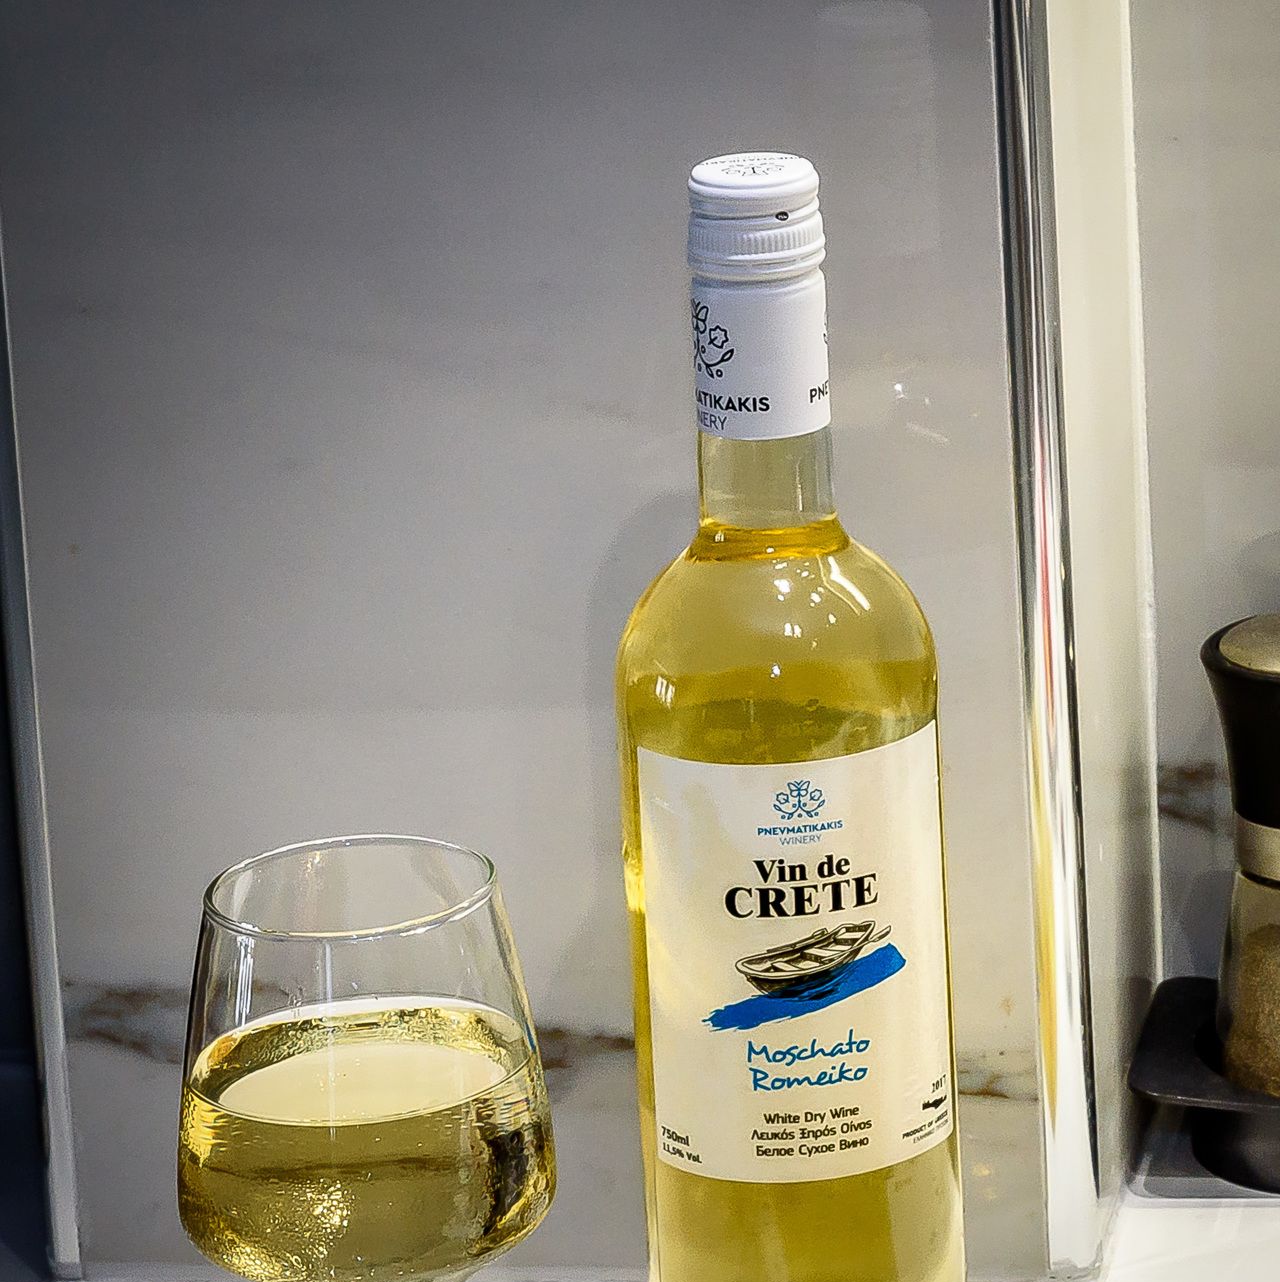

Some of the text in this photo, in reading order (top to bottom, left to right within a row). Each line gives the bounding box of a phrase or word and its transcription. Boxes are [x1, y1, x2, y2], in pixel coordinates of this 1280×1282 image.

[757, 820, 843, 836] PNEVMATIKAKIS
[779, 834, 822, 846] WINERY
[753, 854, 851, 884] Vin de
[725, 873, 879, 918] CRETE
[747, 1028, 870, 1066] Moschato
[749, 1062, 868, 1091] Romeiko
[764, 1107, 860, 1124] White Dry Wine
[661, 1125, 690, 1147] 750ml
[751, 1128, 795, 1140] Λευκός
[840, 1119, 873, 1134] Οίνος
[756, 1136, 869, 1157] Белое Сухое Вино
